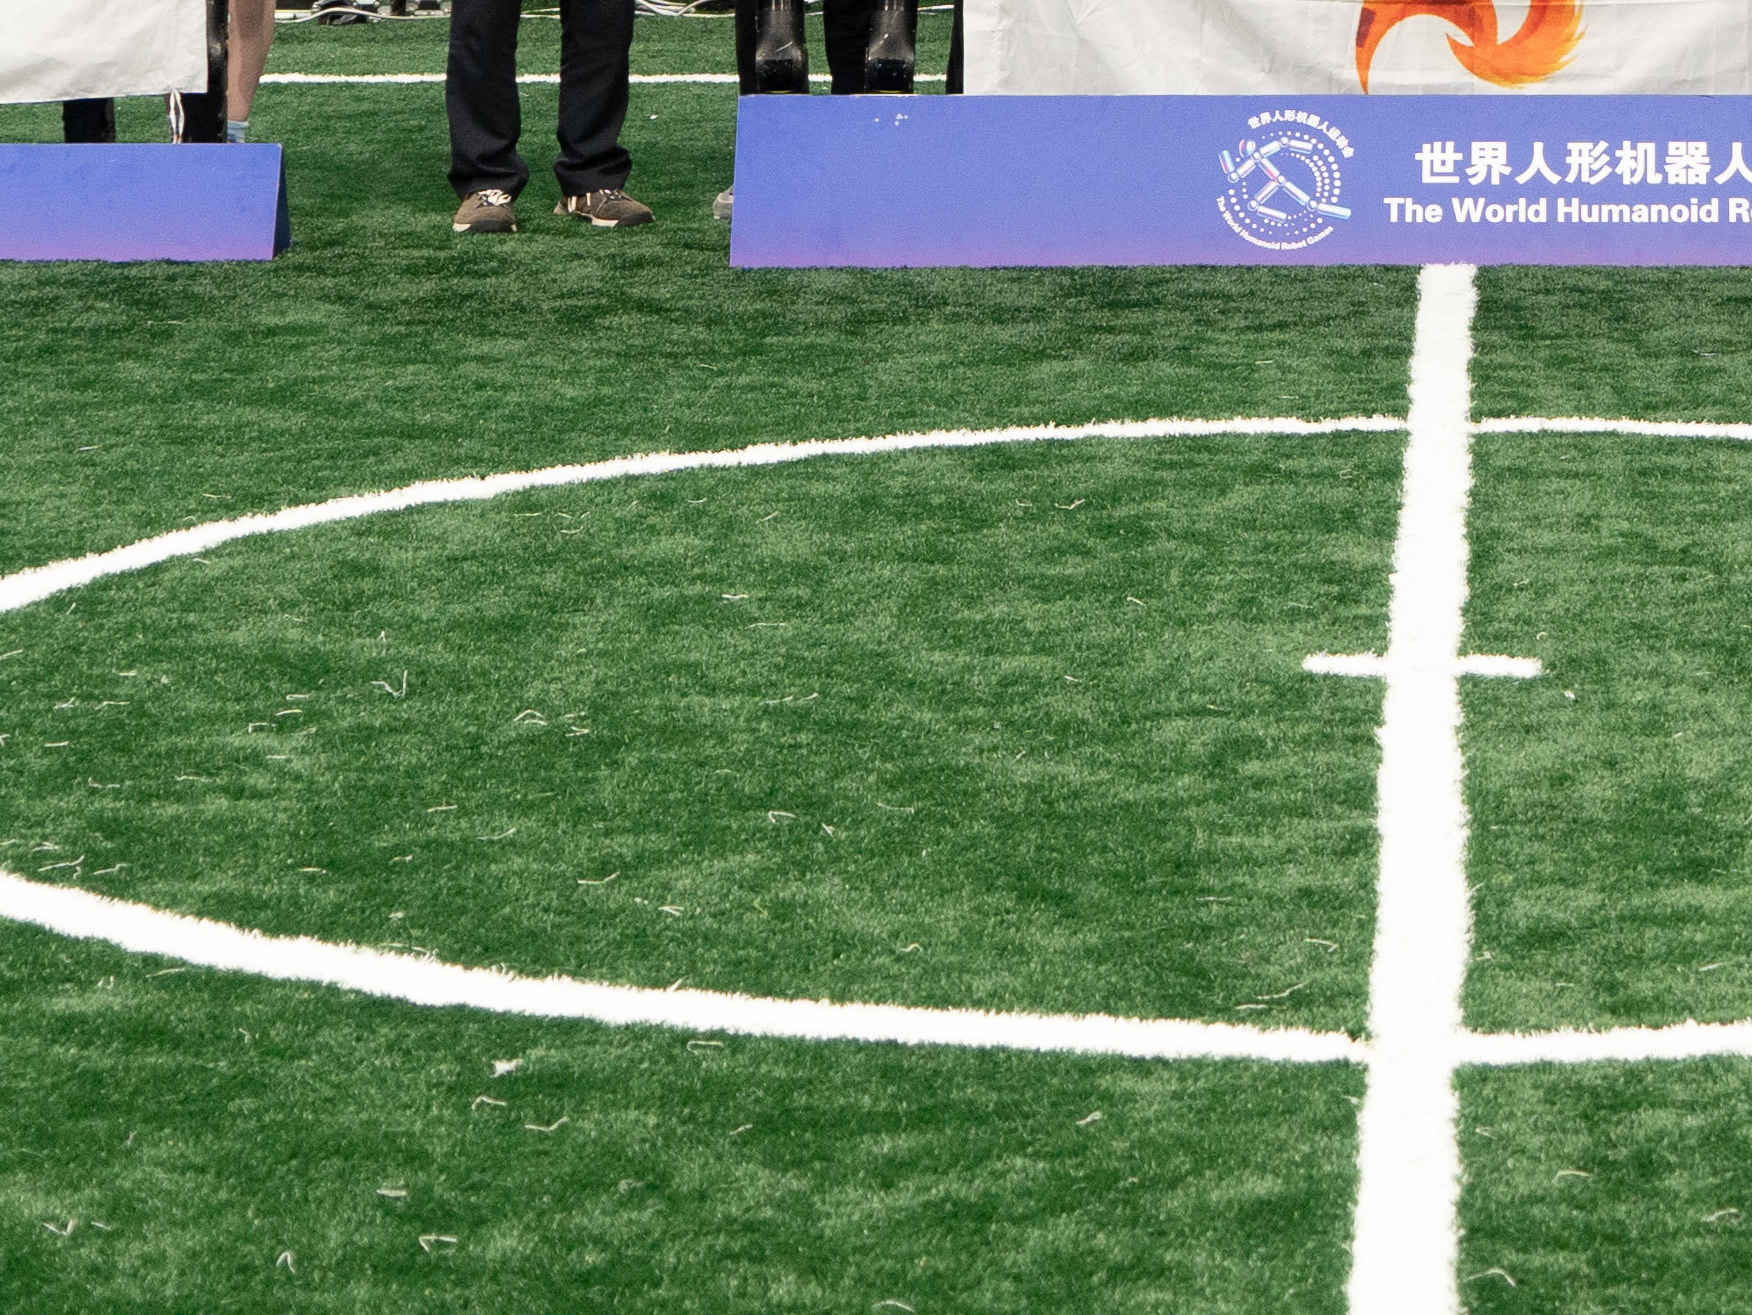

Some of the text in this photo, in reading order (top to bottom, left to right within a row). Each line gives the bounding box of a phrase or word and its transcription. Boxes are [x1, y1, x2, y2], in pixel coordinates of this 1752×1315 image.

[1382, 196, 1444, 225] The
[1451, 196, 1548, 225] World
[1557, 196, 1720, 225] Humanoid
